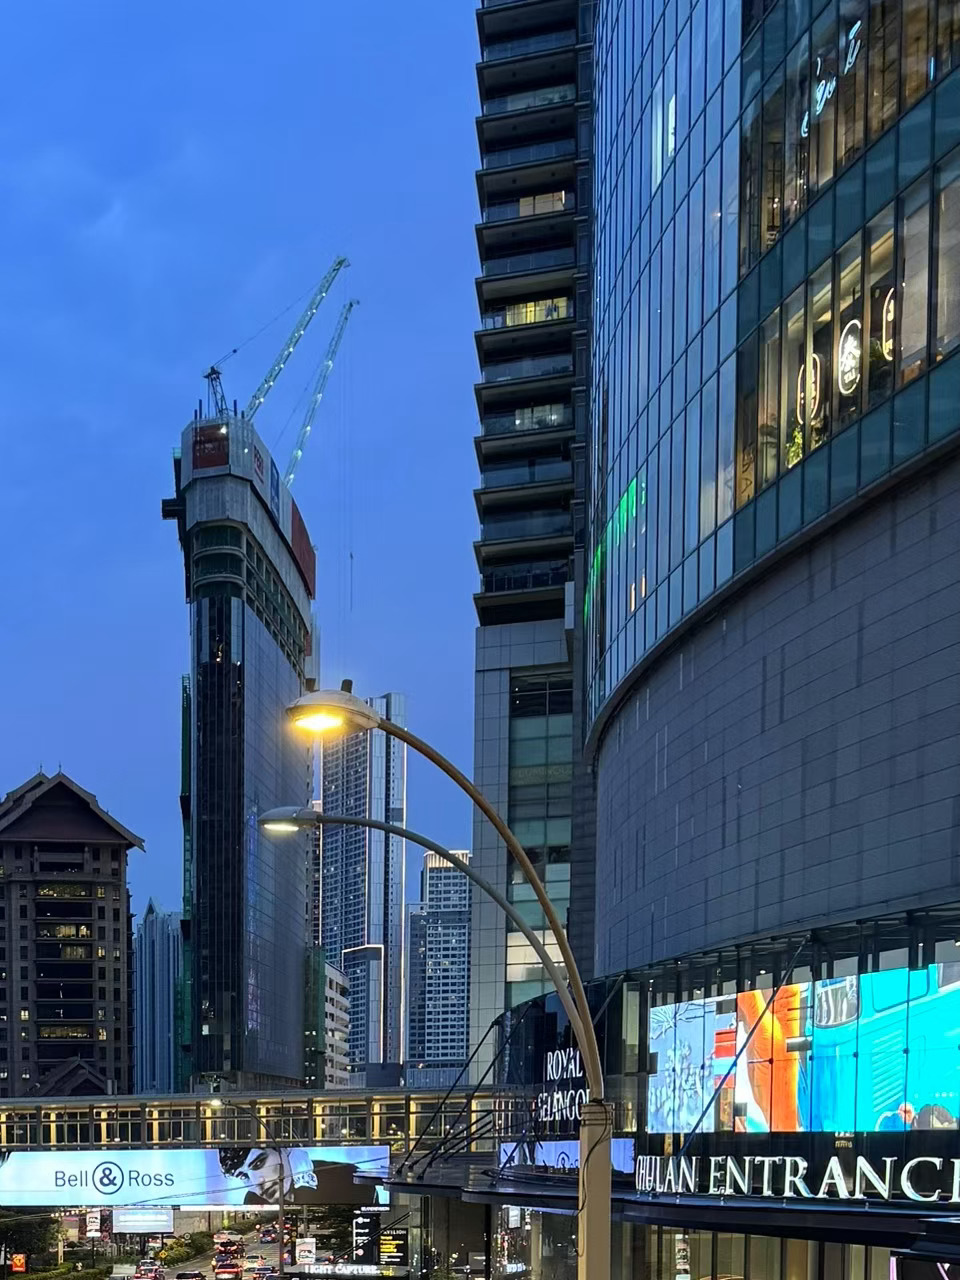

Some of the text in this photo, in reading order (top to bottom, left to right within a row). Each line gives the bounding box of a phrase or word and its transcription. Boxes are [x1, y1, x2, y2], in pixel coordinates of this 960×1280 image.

[547, 1048, 583, 1080] ROYAL
[55, 1170, 88, 1187] Bell
[128, 1170, 175, 1187] Ross
[636, 1155, 699, 1192] CHULAN
